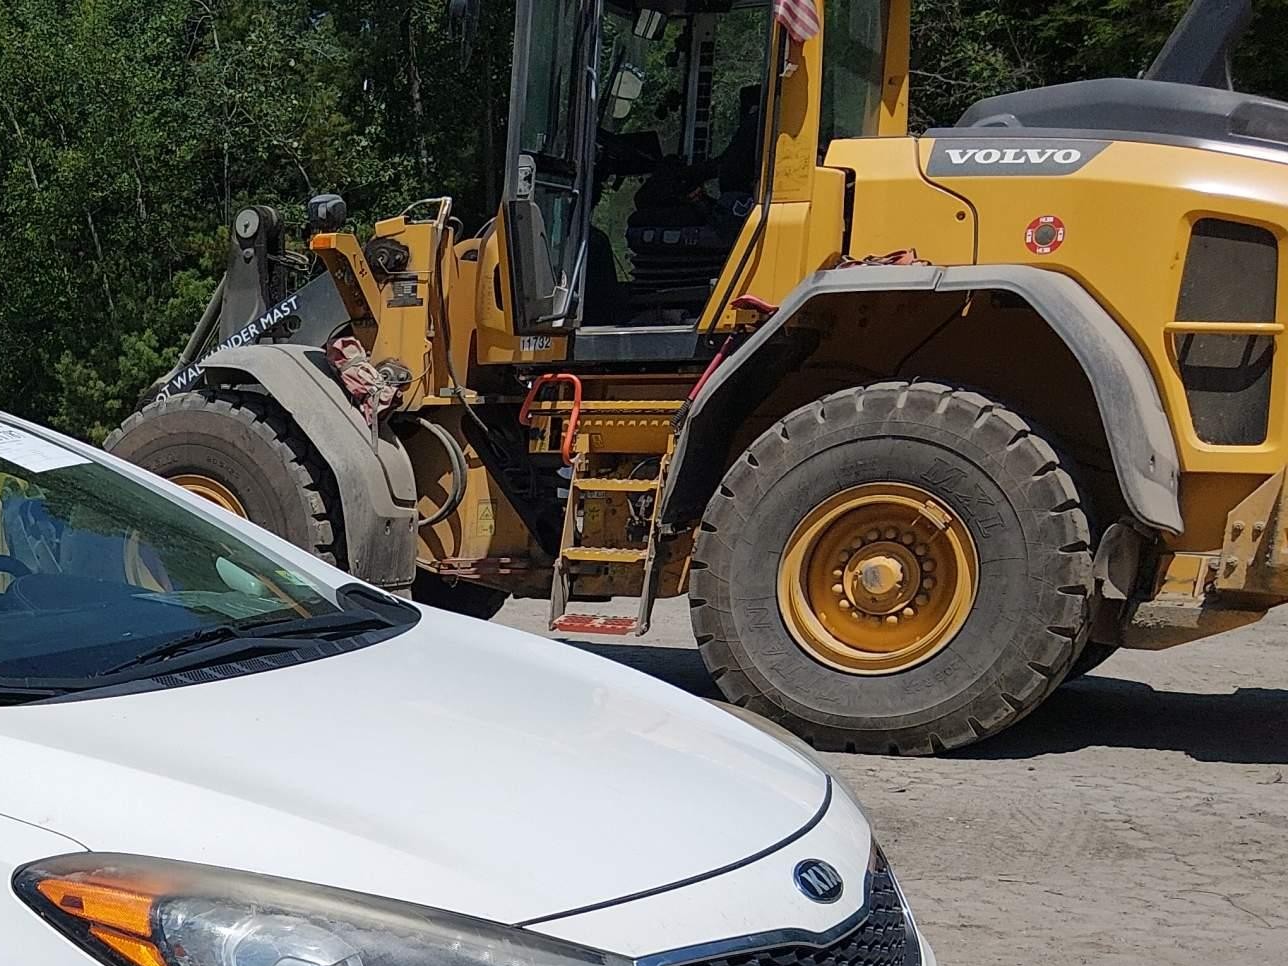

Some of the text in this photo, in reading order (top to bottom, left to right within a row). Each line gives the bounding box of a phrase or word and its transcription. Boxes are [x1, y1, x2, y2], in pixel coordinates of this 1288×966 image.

[944, 148, 1081, 164] VOLVO
[156, 384, 170, 402] OT
[172, 355, 210, 389] WAL
[260, 296, 298, 330] MAST
[799, 861, 842, 896] KIA
